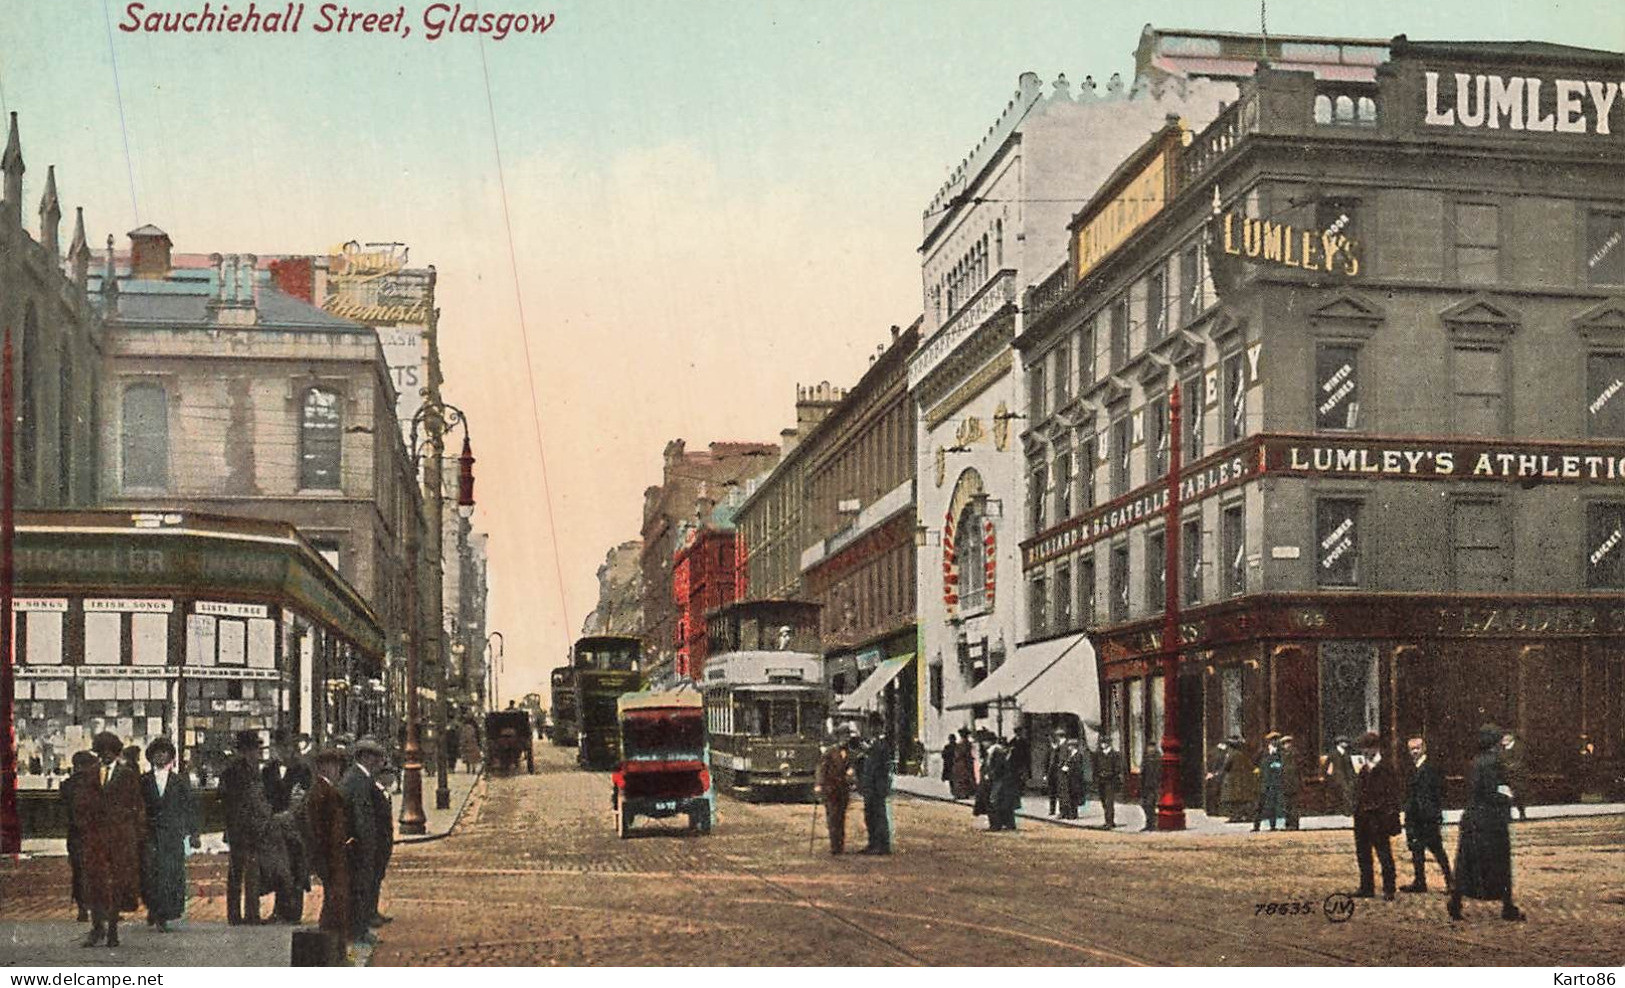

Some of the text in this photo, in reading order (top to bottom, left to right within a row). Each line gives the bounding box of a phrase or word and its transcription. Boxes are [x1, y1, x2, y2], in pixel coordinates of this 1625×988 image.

[1224, 213, 1359, 277] LUMLEY'S
[1322, 364, 1352, 392] WINTER
[1319, 380, 1355, 415] PASTIMES
[1590, 379, 1623, 414] FOOTBALL
[1290, 447, 1454, 475] LUMLEY'S
[1093, 489, 1170, 537] BAGATELLE
[1321, 518, 1354, 549] SUMMER
[1590, 530, 1622, 564] CRICKET
[1322, 537, 1352, 568] SPORTS
[26, 600, 63, 609] SONGS
[91, 601, 167, 610] IRISH SONGS
